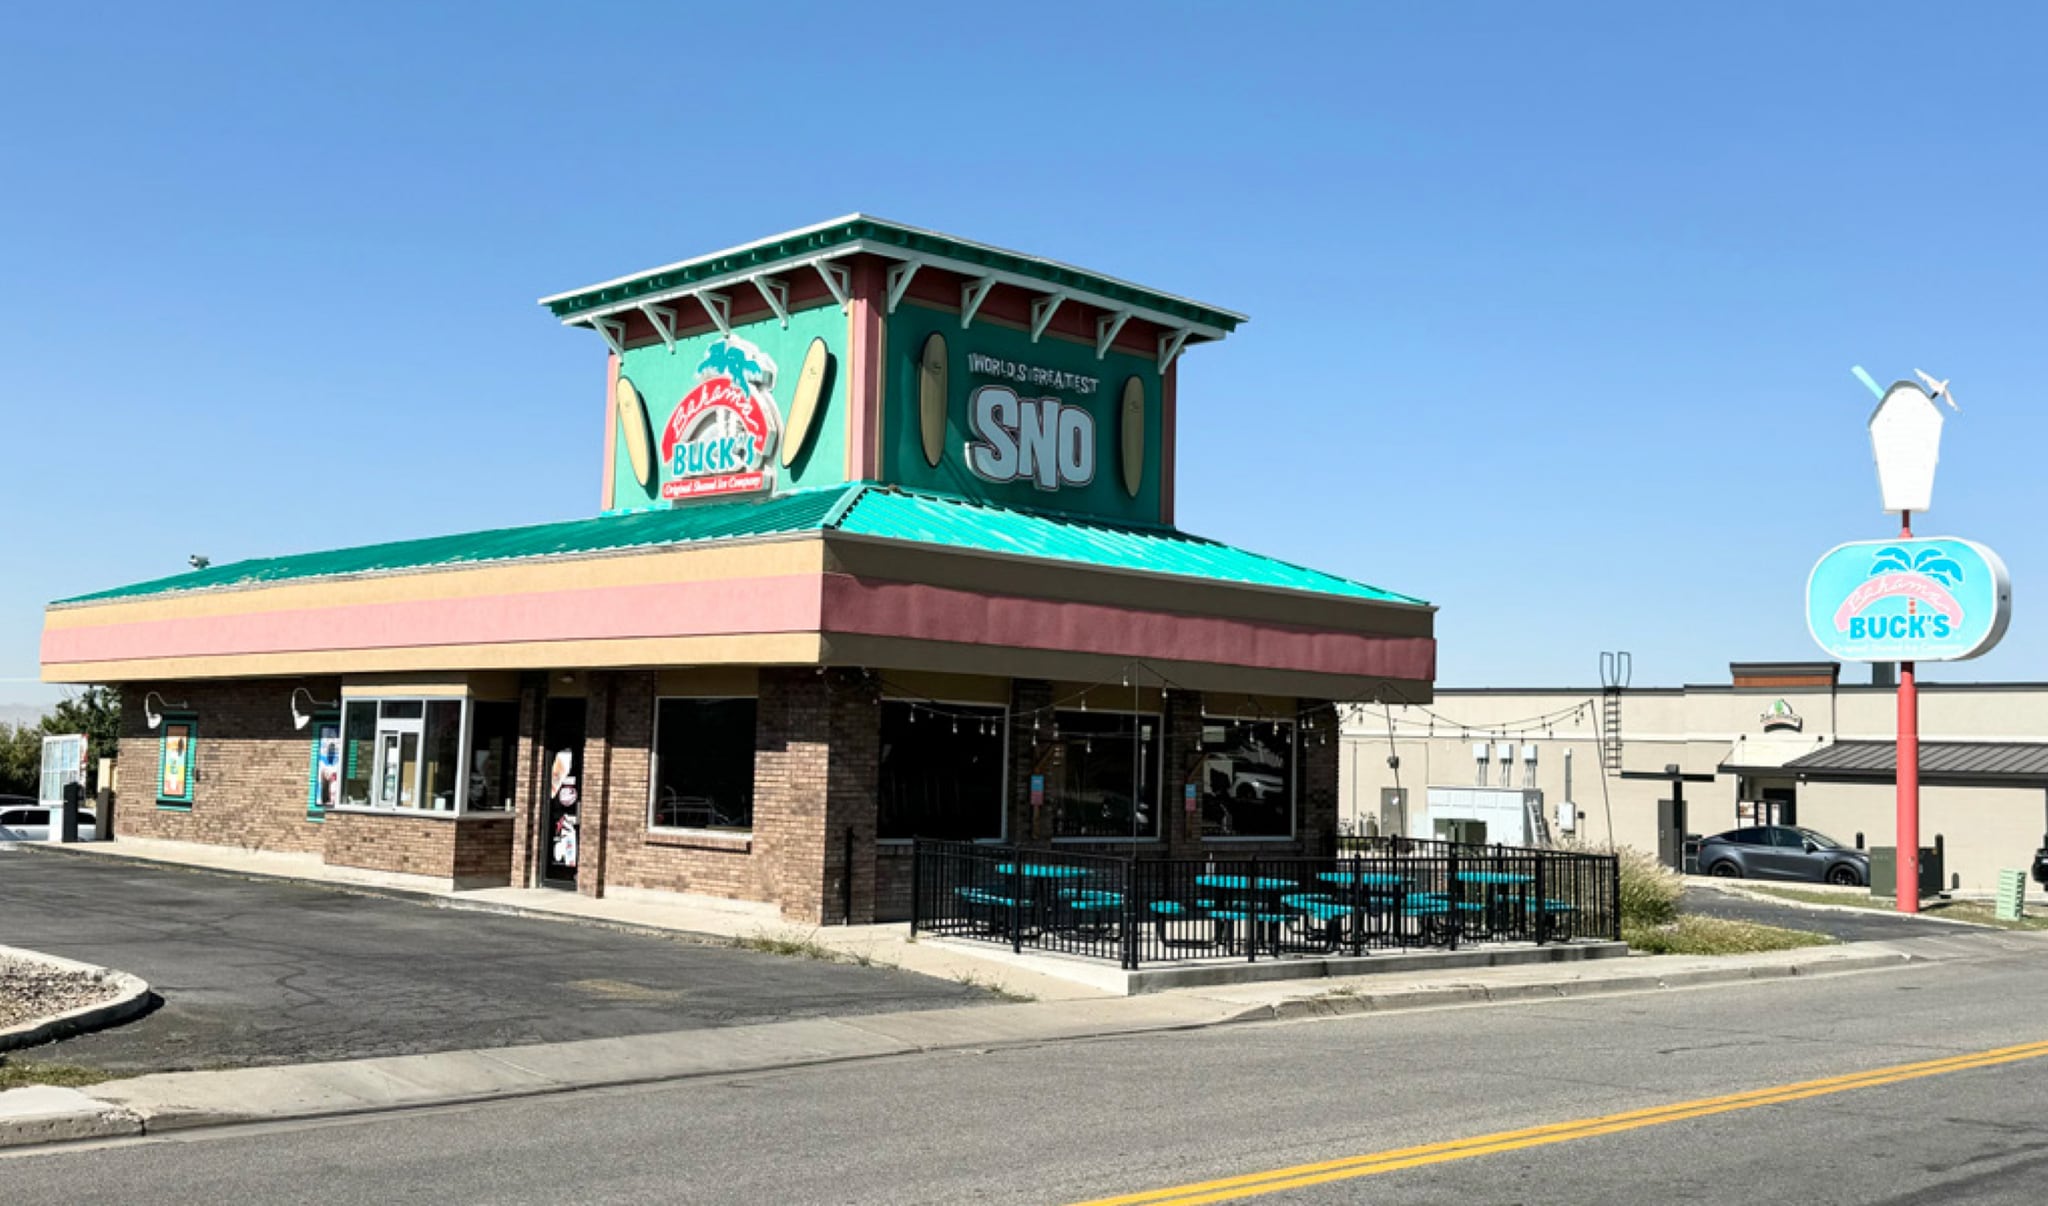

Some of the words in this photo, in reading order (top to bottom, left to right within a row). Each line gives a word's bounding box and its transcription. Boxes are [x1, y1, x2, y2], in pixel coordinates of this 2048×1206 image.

[1029, 366, 1100, 394] GREATEST
[672, 384, 760, 440] Bahama
[672, 435, 756, 477] BUCK'S
[967, 384, 1097, 491] SNO
[1848, 577, 1951, 612] Bahama
[1850, 614, 1950, 640] BUCK'S
